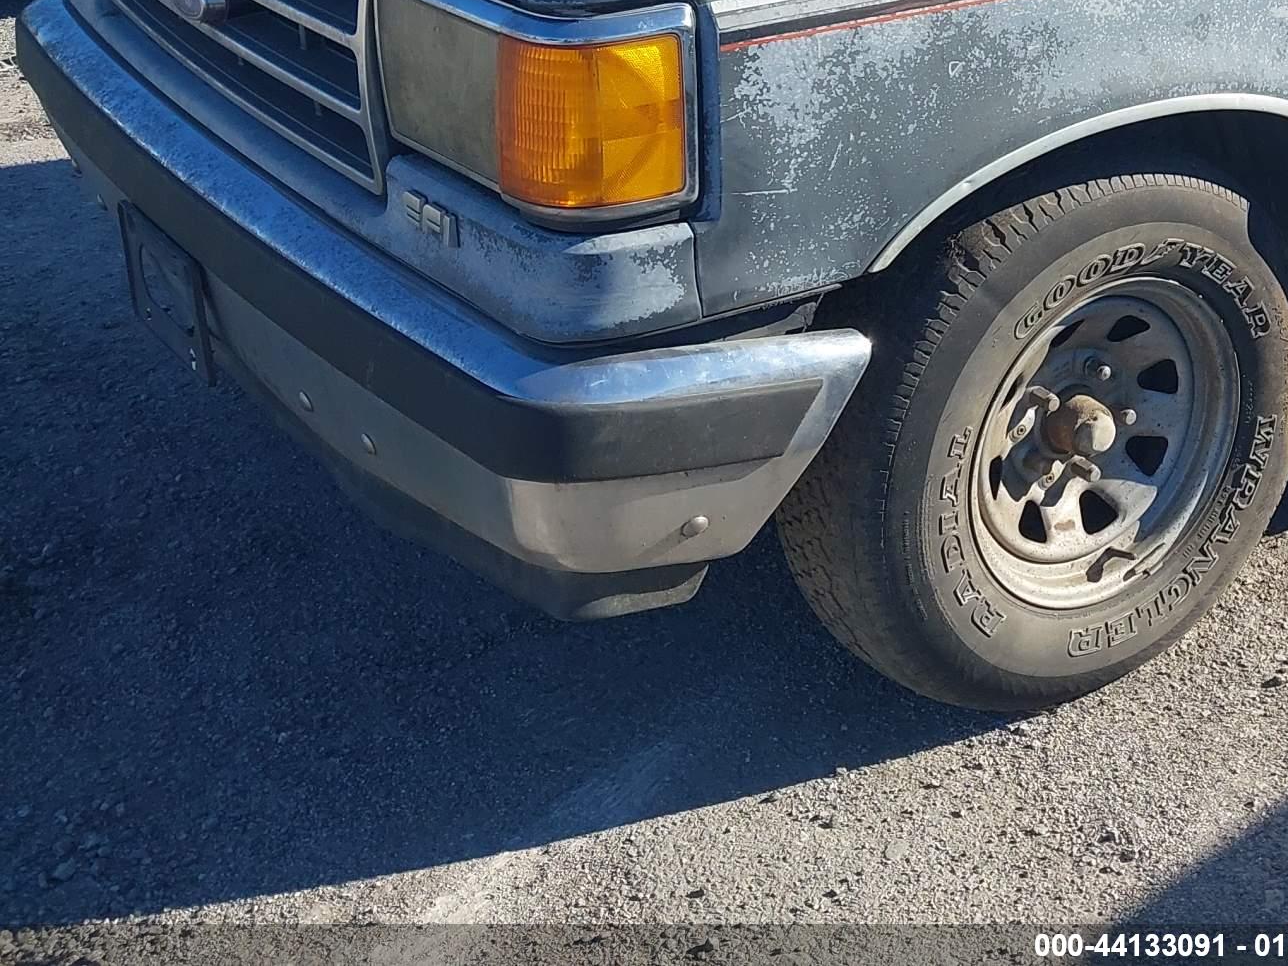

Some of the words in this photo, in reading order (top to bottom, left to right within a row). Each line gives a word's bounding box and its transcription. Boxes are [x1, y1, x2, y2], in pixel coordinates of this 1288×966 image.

[403, 188, 458, 247] EFI
[1014, 238, 1272, 339] GOODYEAR
[940, 425, 1005, 639] RADIAL
[1066, 414, 1278, 658] WRANGLER
